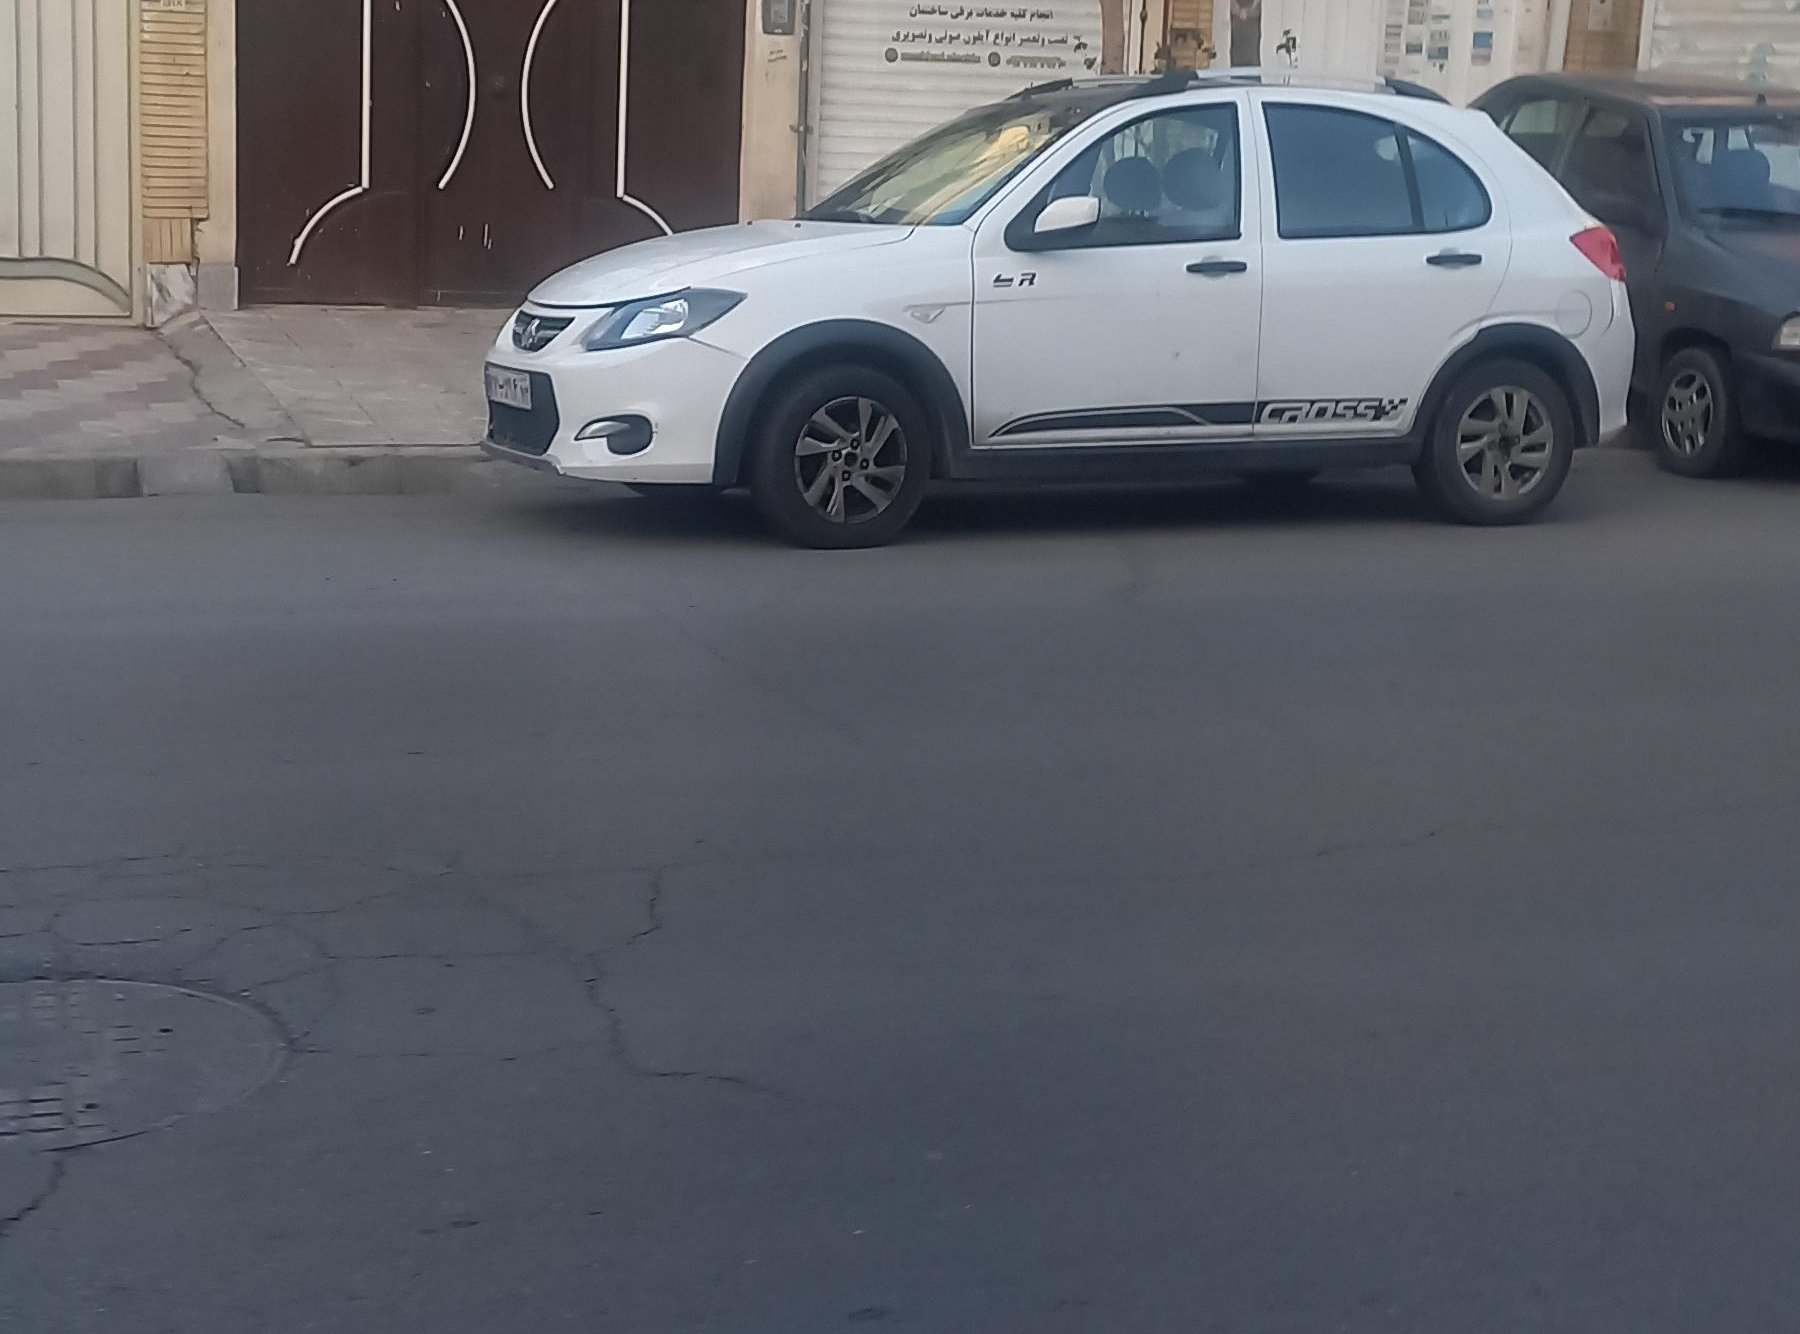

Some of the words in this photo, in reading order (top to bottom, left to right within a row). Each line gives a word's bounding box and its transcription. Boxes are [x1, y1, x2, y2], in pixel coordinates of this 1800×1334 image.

[909, 3, 948, 18] ساختمان
[950, 5, 974, 20] برقی
[976, 7, 1007, 18] خدمات
[1010, 8, 1027, 21] کلیه
[1029, 9, 1053, 22] انجام
[963, 29, 991, 46] آیفون
[993, 31, 1016, 46] انواع
[1261, 400, 1379, 424] CROSS
